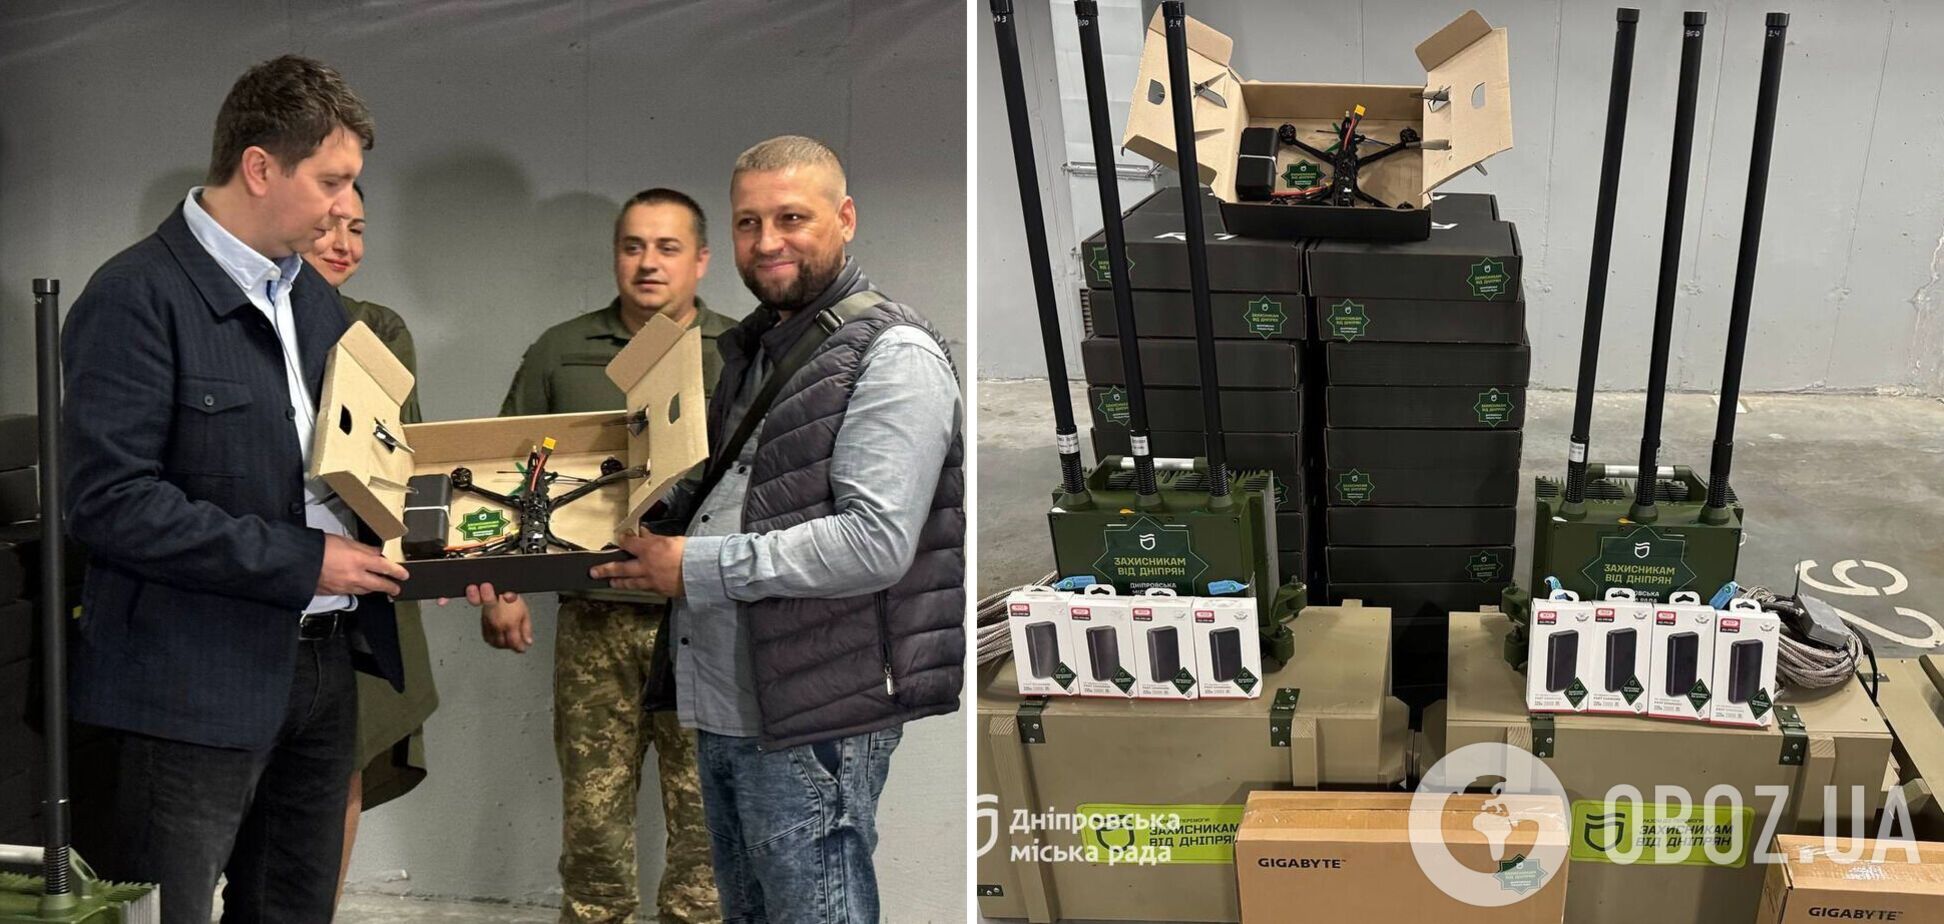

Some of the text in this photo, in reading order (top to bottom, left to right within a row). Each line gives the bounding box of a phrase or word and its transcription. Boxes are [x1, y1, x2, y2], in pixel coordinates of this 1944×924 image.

[1113, 557, 1187, 566] ЗАХИСНИКАМ
[1117, 567, 1186, 577] ВІД ДНІПРЯН
[1603, 563, 1676, 575] ЗАХИСНИКАМ
[1605, 573, 1672, 585] ВІД ДНІПРЯН
[1149, 837, 1174, 848] ВІД
[1257, 858, 1342, 869] GIGABYTE
[1808, 907, 1898, 921] GIGABYTE
